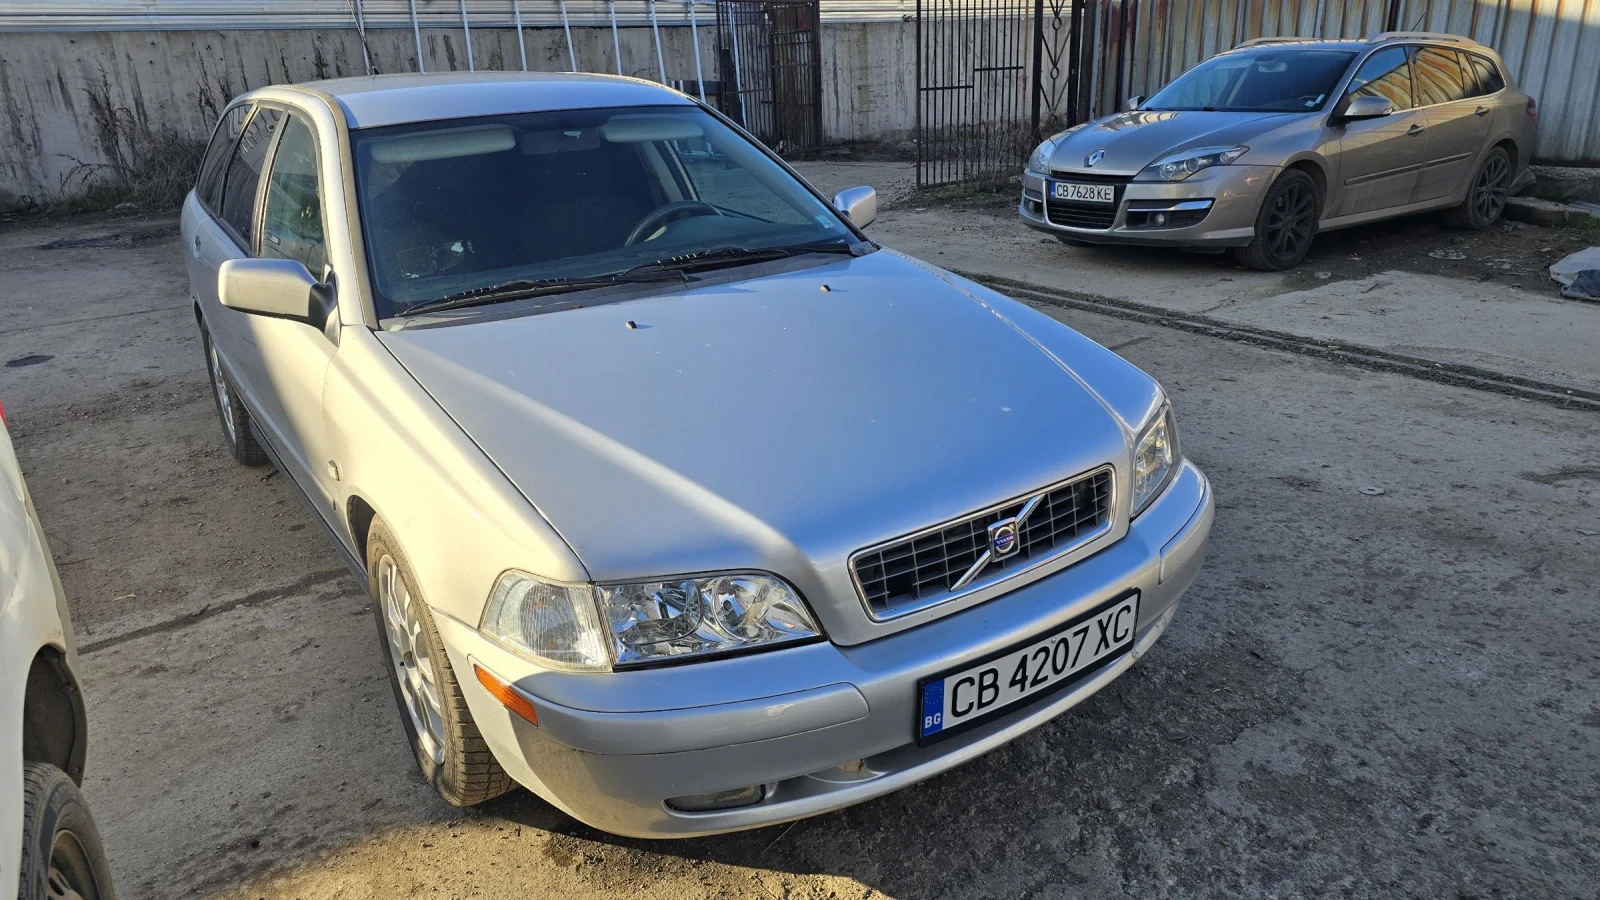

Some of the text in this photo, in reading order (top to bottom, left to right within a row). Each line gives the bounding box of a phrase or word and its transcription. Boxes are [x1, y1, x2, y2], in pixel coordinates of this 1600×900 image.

[1056, 184, 1069, 197] CB
[1071, 185, 1095, 199] 7628
[1097, 187, 1112, 201] KE
[996, 536, 1014, 545] VOLVO
[951, 604, 1132, 718] CB 4207 XC
[924, 712, 942, 729] BG
